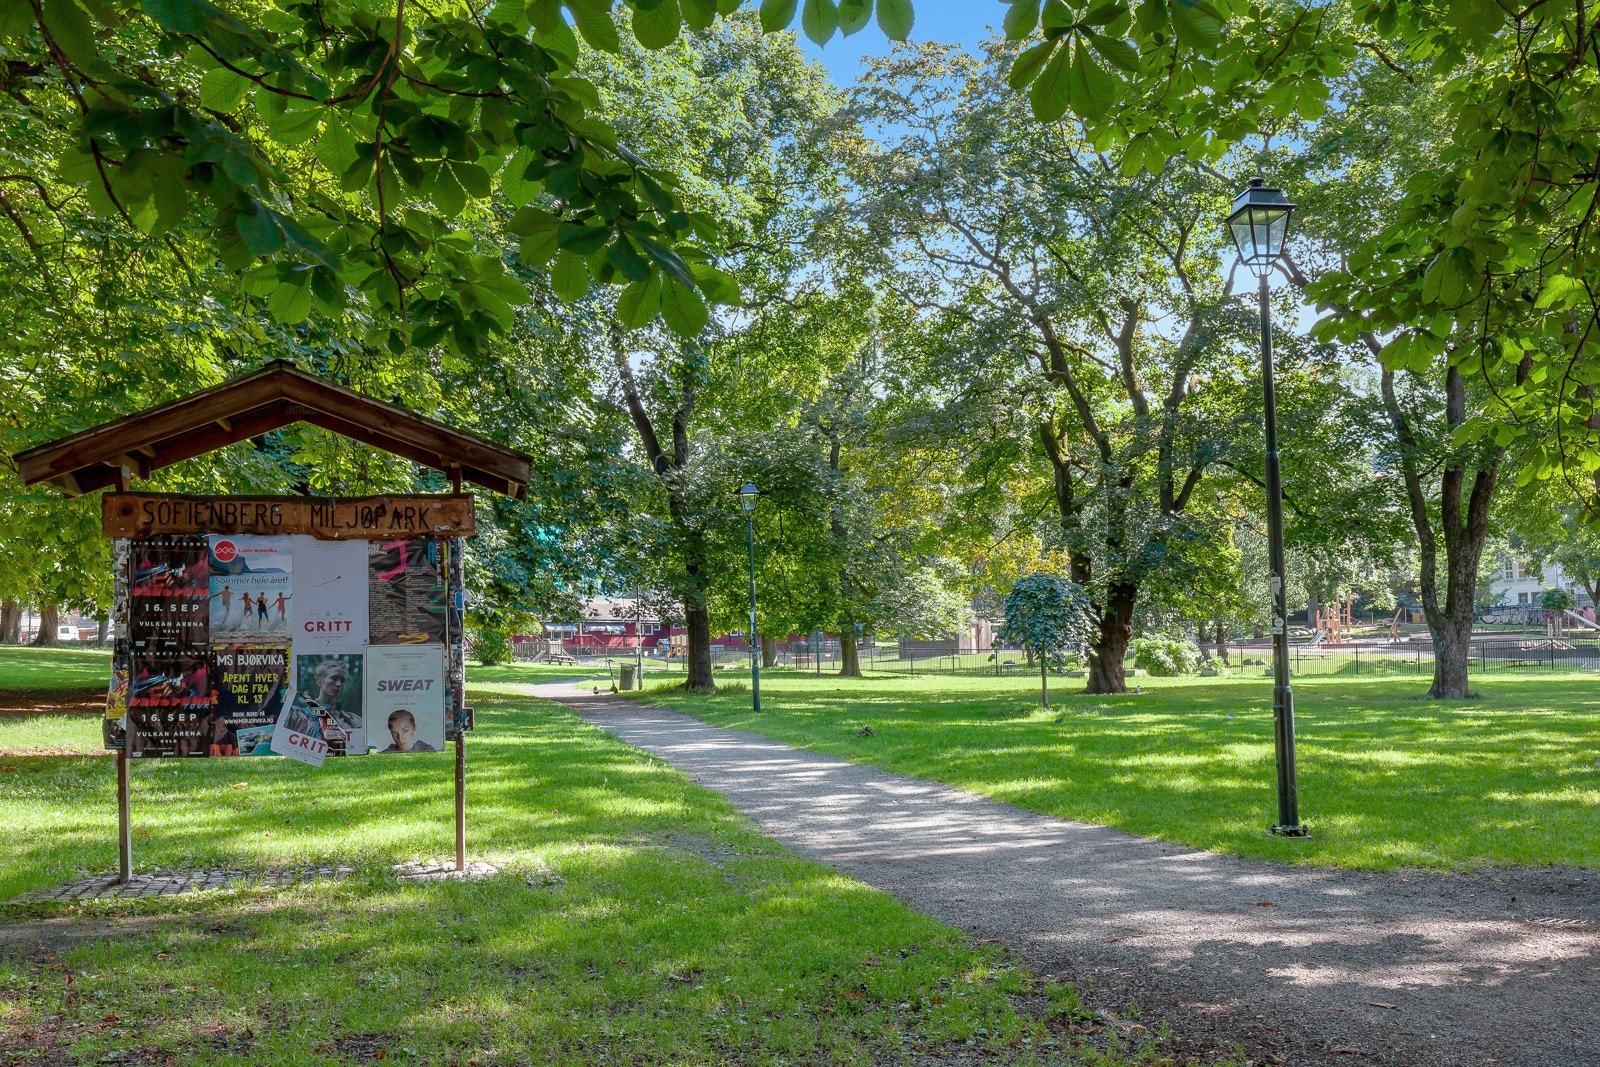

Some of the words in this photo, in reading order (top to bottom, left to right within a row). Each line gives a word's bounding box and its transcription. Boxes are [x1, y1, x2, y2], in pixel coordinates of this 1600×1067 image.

[143, 501, 283, 527] SOFIENBERG
[310, 504, 431, 529] MILJØPARK
[215, 577, 250, 585] Sommer
[269, 576, 289, 584] året!
[144, 603, 163, 612] 16.
[170, 604, 199, 612] SEP
[304, 620, 353, 632] GRITT
[216, 655, 233, 666] MS
[237, 654, 285, 666] BJØRVIKA
[222, 672, 251, 683] ÅPENT
[255, 673, 279, 683] HVER
[231, 684, 249, 694] DAG
[252, 683, 269, 693] FRA
[376, 679, 435, 692] SWEAT
[237, 695, 249, 704] KL
[253, 694, 263, 704] 13
[141, 713, 161, 722] 16.
[167, 713, 197, 722] SEP
